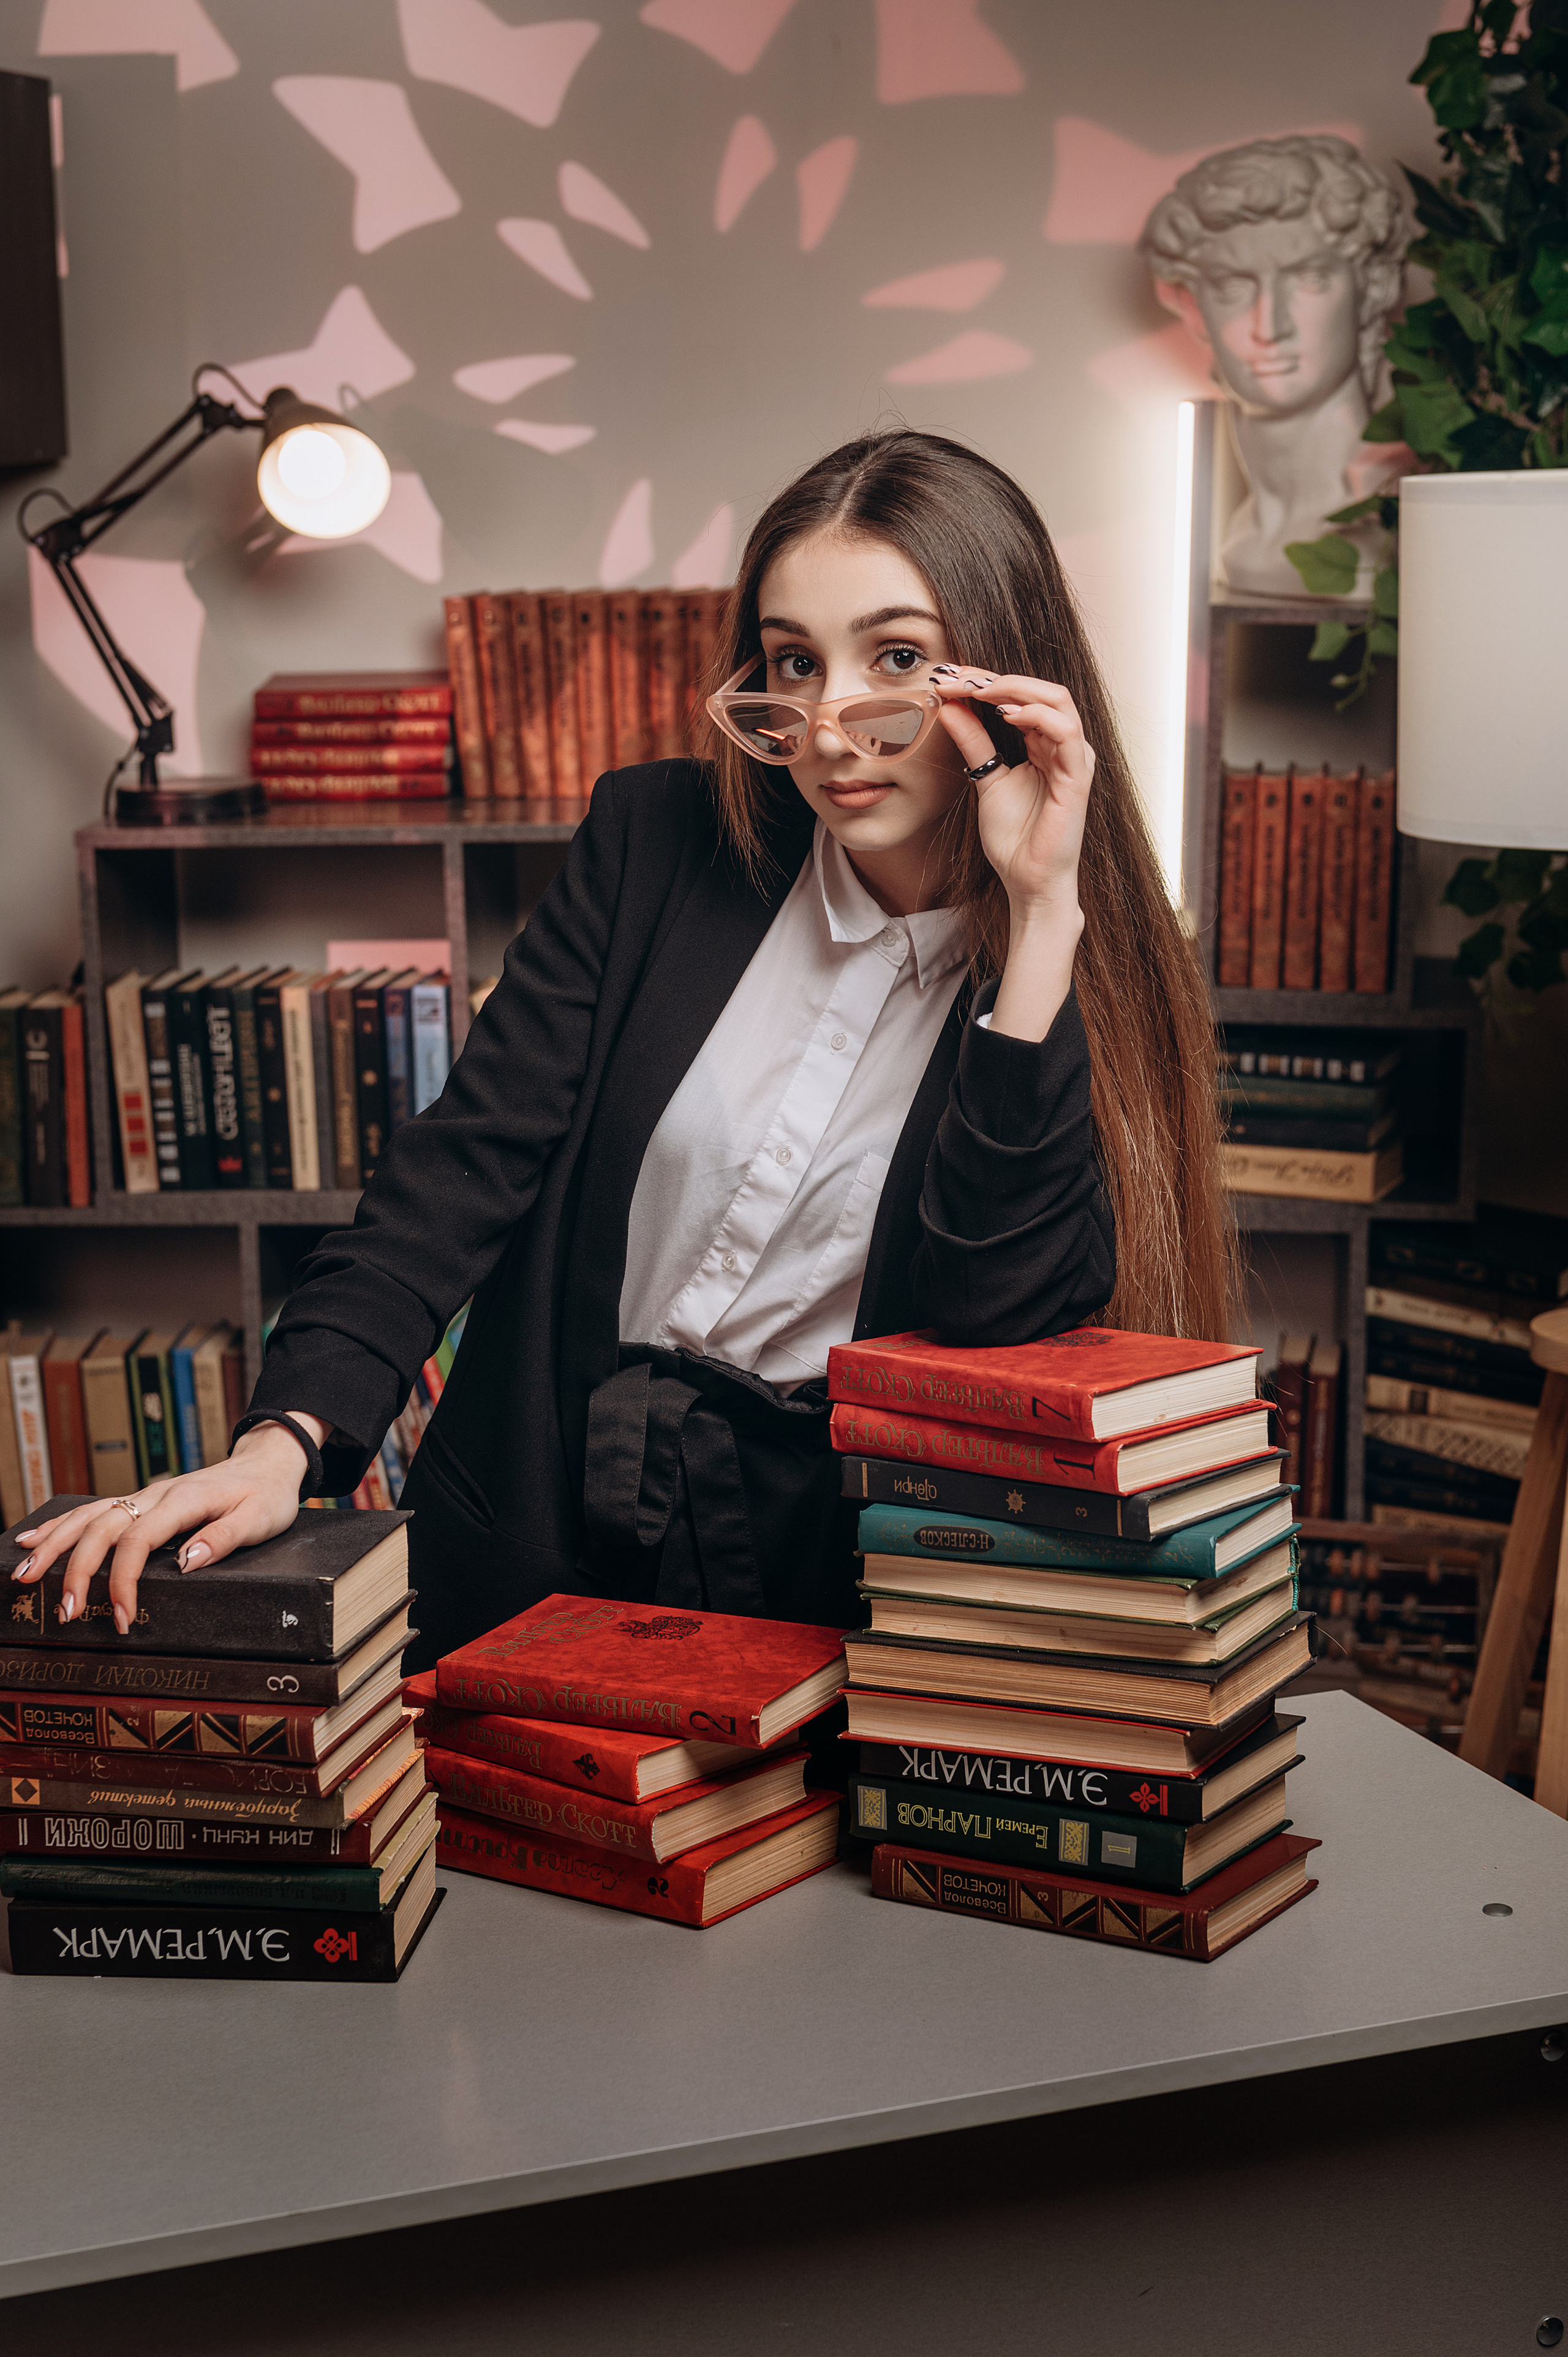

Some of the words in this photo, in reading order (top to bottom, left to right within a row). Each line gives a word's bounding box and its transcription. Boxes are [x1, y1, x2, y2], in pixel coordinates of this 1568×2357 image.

[841, 1366, 915, 1402] СКОТТ
[846, 1420, 926, 1458] СКОТТ
[1075, 1506, 1088, 1518] 3
[549, 1605, 624, 1643] СКОТТ
[94, 1659, 210, 1689] НИКОЛАЙ
[268, 1674, 301, 1693] 3
[454, 1678, 547, 1713] СКОТТ
[24, 1708, 94, 1727] КОЧЕТОВ
[26, 1727, 96, 1744] Всеволод
[88, 1791, 176, 1807] детектив
[184, 1796, 302, 1822] Зарубежный
[557, 1803, 636, 1848] СКОТТ
[897, 1803, 992, 1839] ПАРНОВ
[44, 1818, 184, 1850] ШОРОХИ
[203, 1826, 263, 1846] КУНЦ
[269, 1829, 314, 1847] ДИН
[944, 1874, 1006, 1894] КОЧЕТОВ
[944, 1891, 1006, 1914] Всеволод
